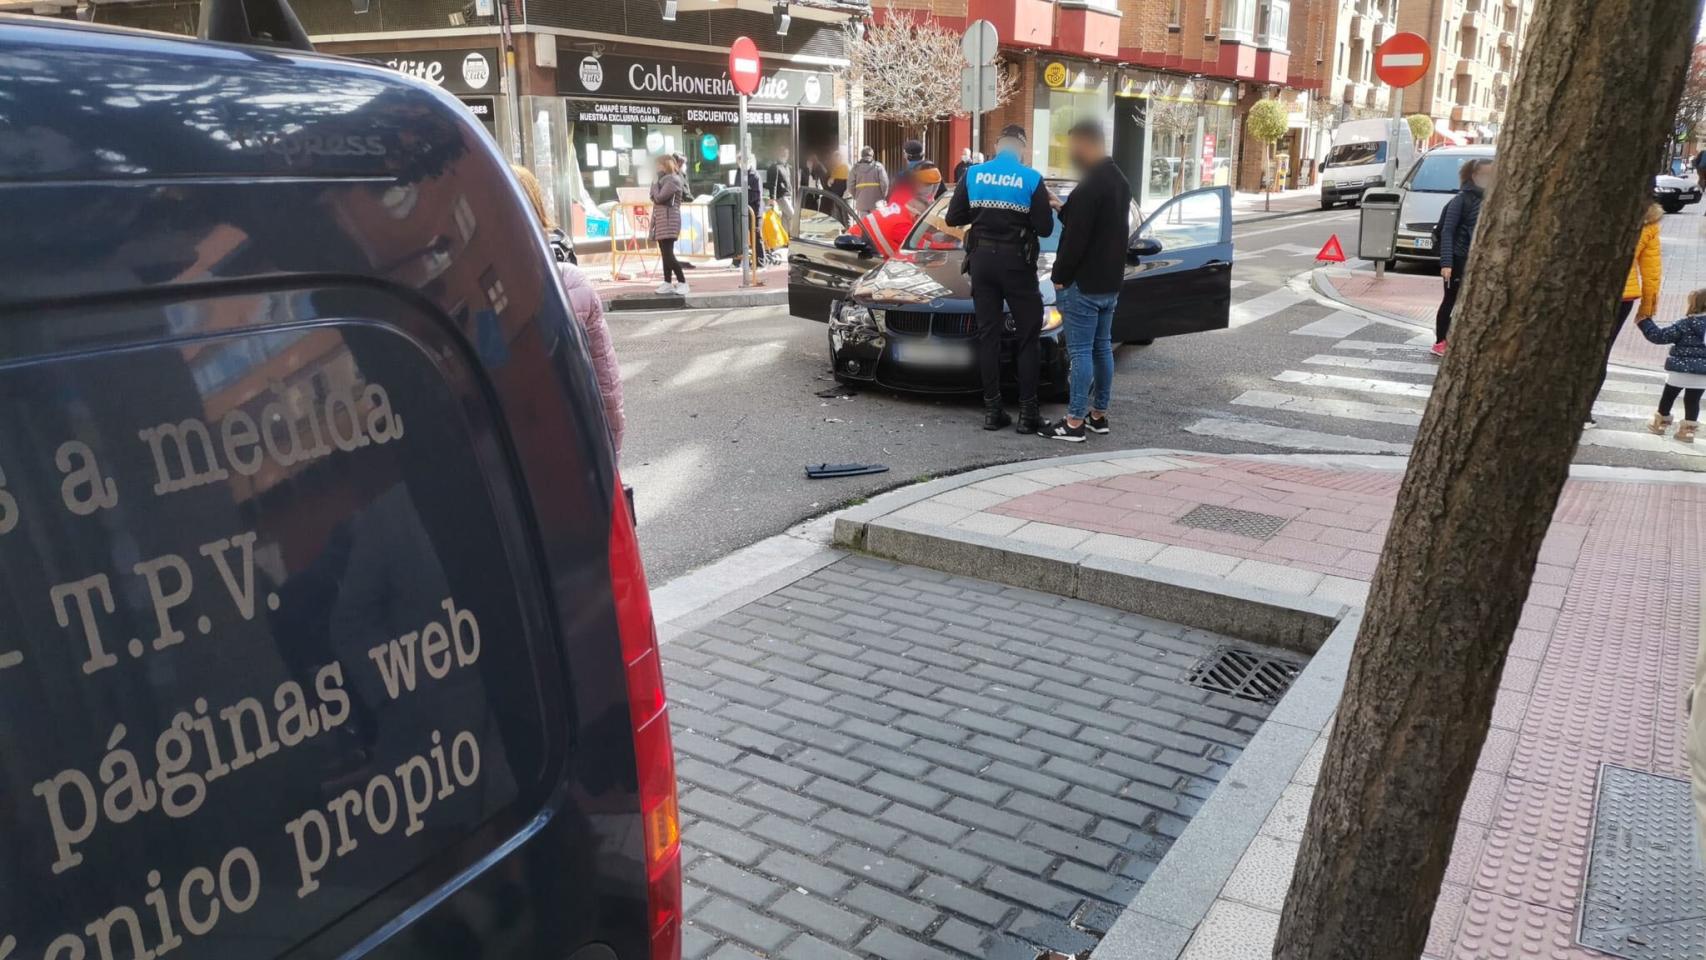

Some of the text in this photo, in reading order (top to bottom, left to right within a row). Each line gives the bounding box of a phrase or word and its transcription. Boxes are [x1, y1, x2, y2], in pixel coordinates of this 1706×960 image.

[386, 58, 445, 86] lite
[751, 75, 789, 100] lite
[580, 112, 608, 121] NUESTRA
[620, 105, 628, 114] DE
[628, 106, 652, 115] REGALO
[687, 109, 739, 123] DESCUENTOS
[745, 112, 763, 124] ESDE
[975, 171, 1023, 189] POLICÍA
[55, 440, 118, 515] a
[138, 371, 404, 496] medida
[50, 531, 280, 674] T.P.V.
[32, 597, 481, 874] páginas web
[0, 730, 480, 960] nico propio
